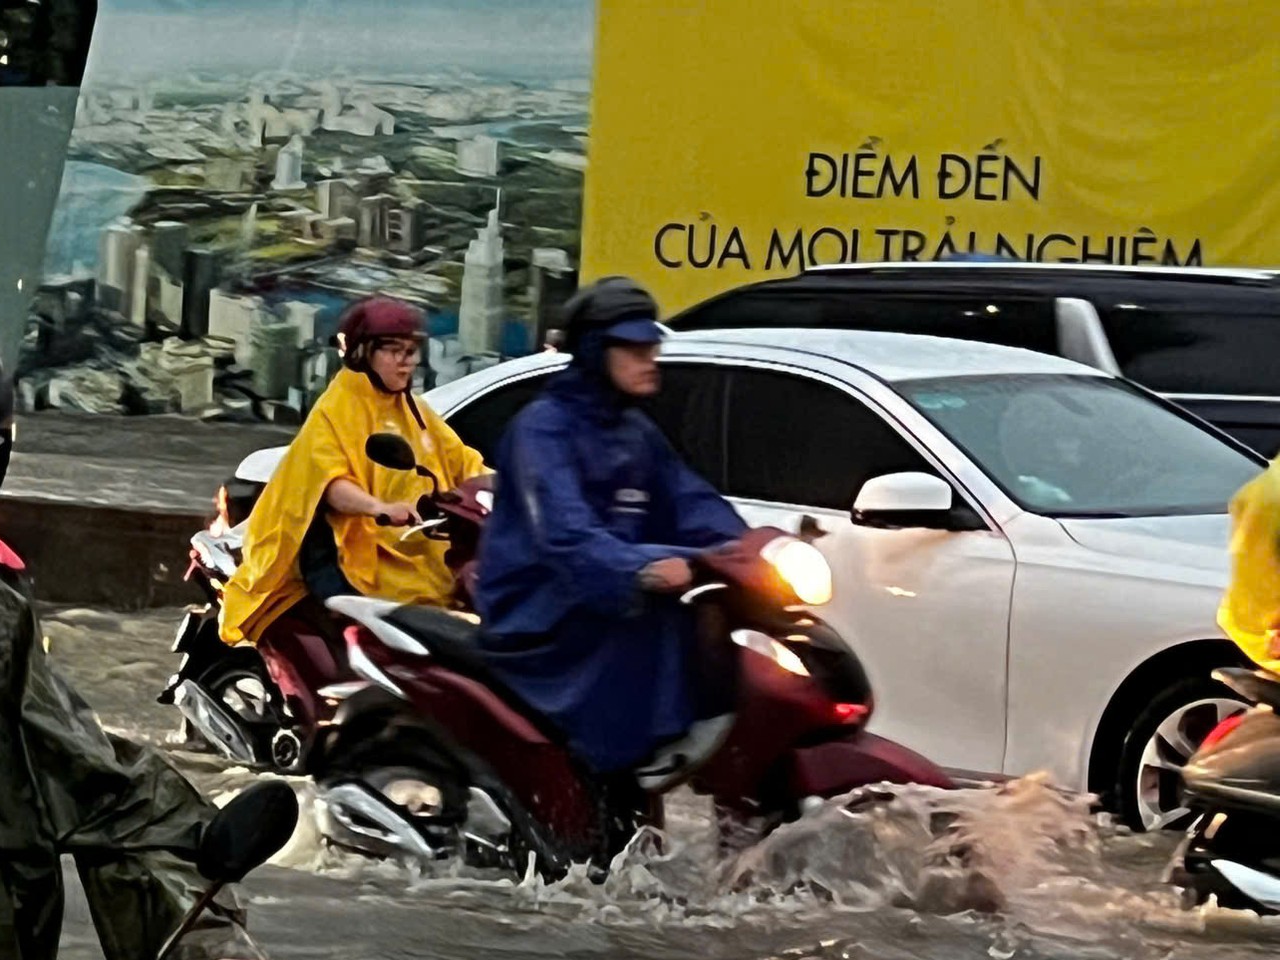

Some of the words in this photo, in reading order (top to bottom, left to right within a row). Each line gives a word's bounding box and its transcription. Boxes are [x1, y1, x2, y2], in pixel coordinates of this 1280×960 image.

[805, 135, 919, 199] ĐIỂM
[937, 138, 1041, 200] ĐẾN
[654, 211, 751, 269] CỦA
